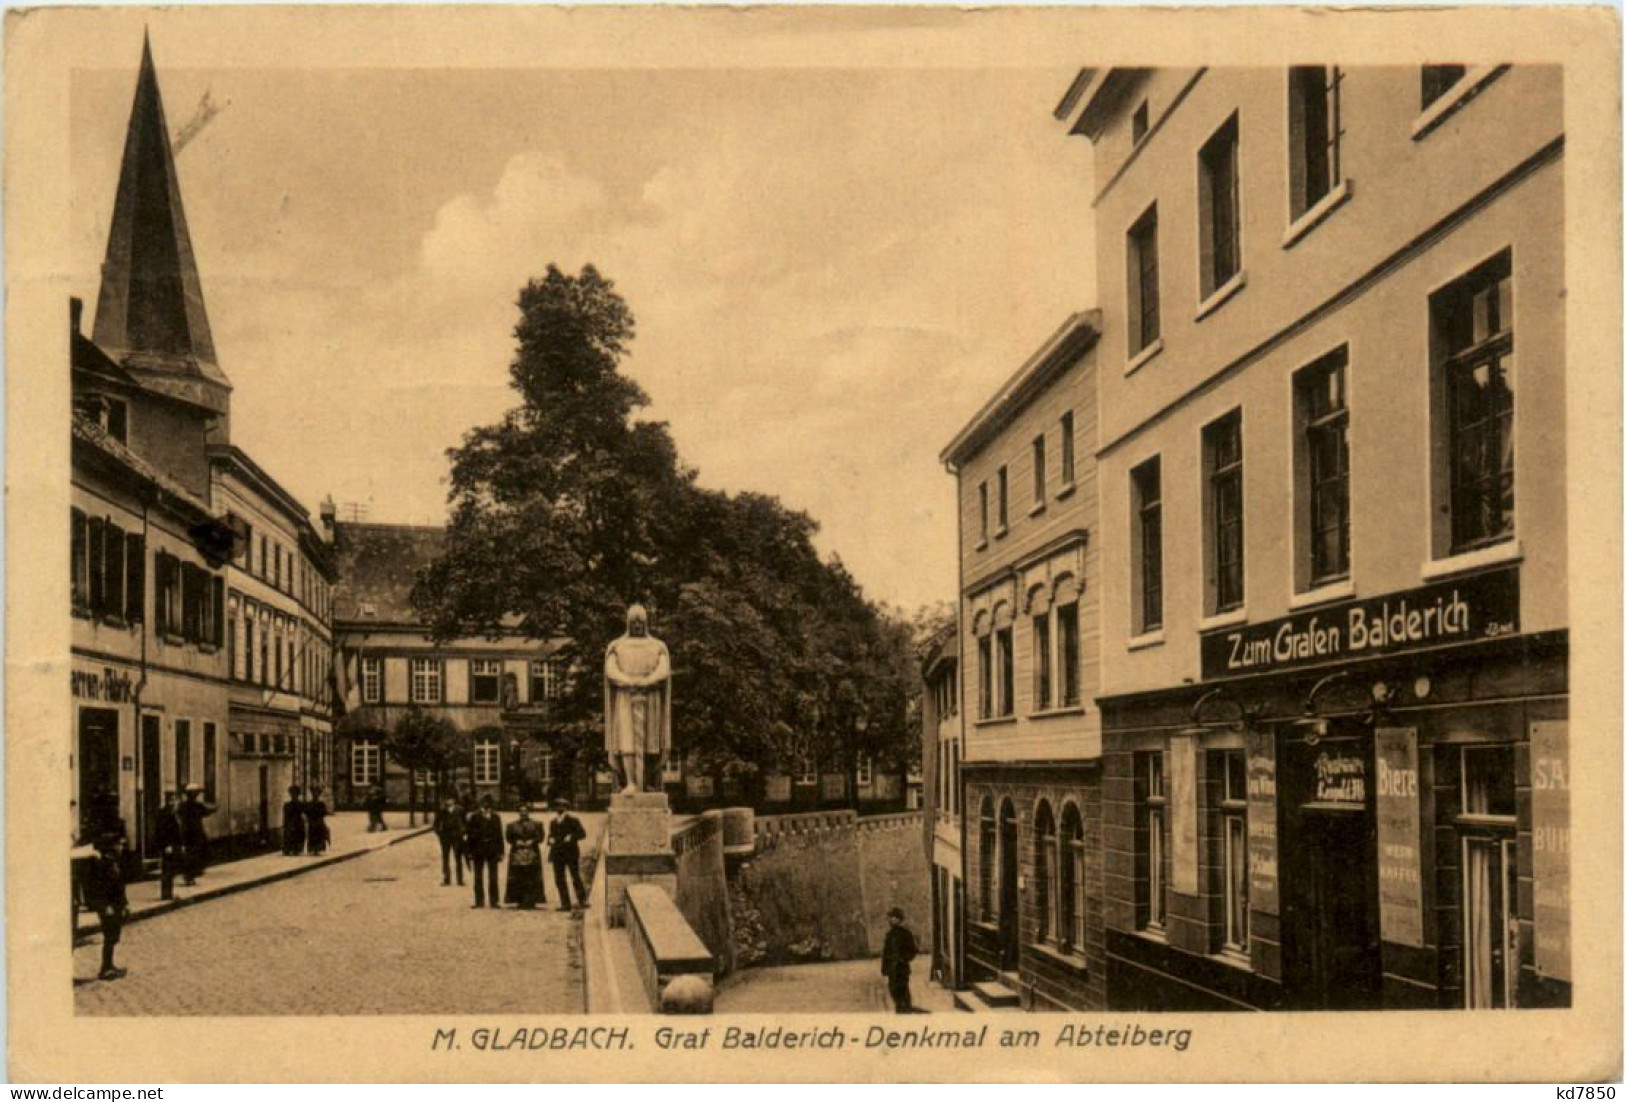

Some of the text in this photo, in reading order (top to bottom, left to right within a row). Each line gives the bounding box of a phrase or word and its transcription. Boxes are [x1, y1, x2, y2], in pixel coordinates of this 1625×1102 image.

[1227, 589, 1469, 669] Zum Grafen Balderich
[1377, 757, 1417, 796] Biere
